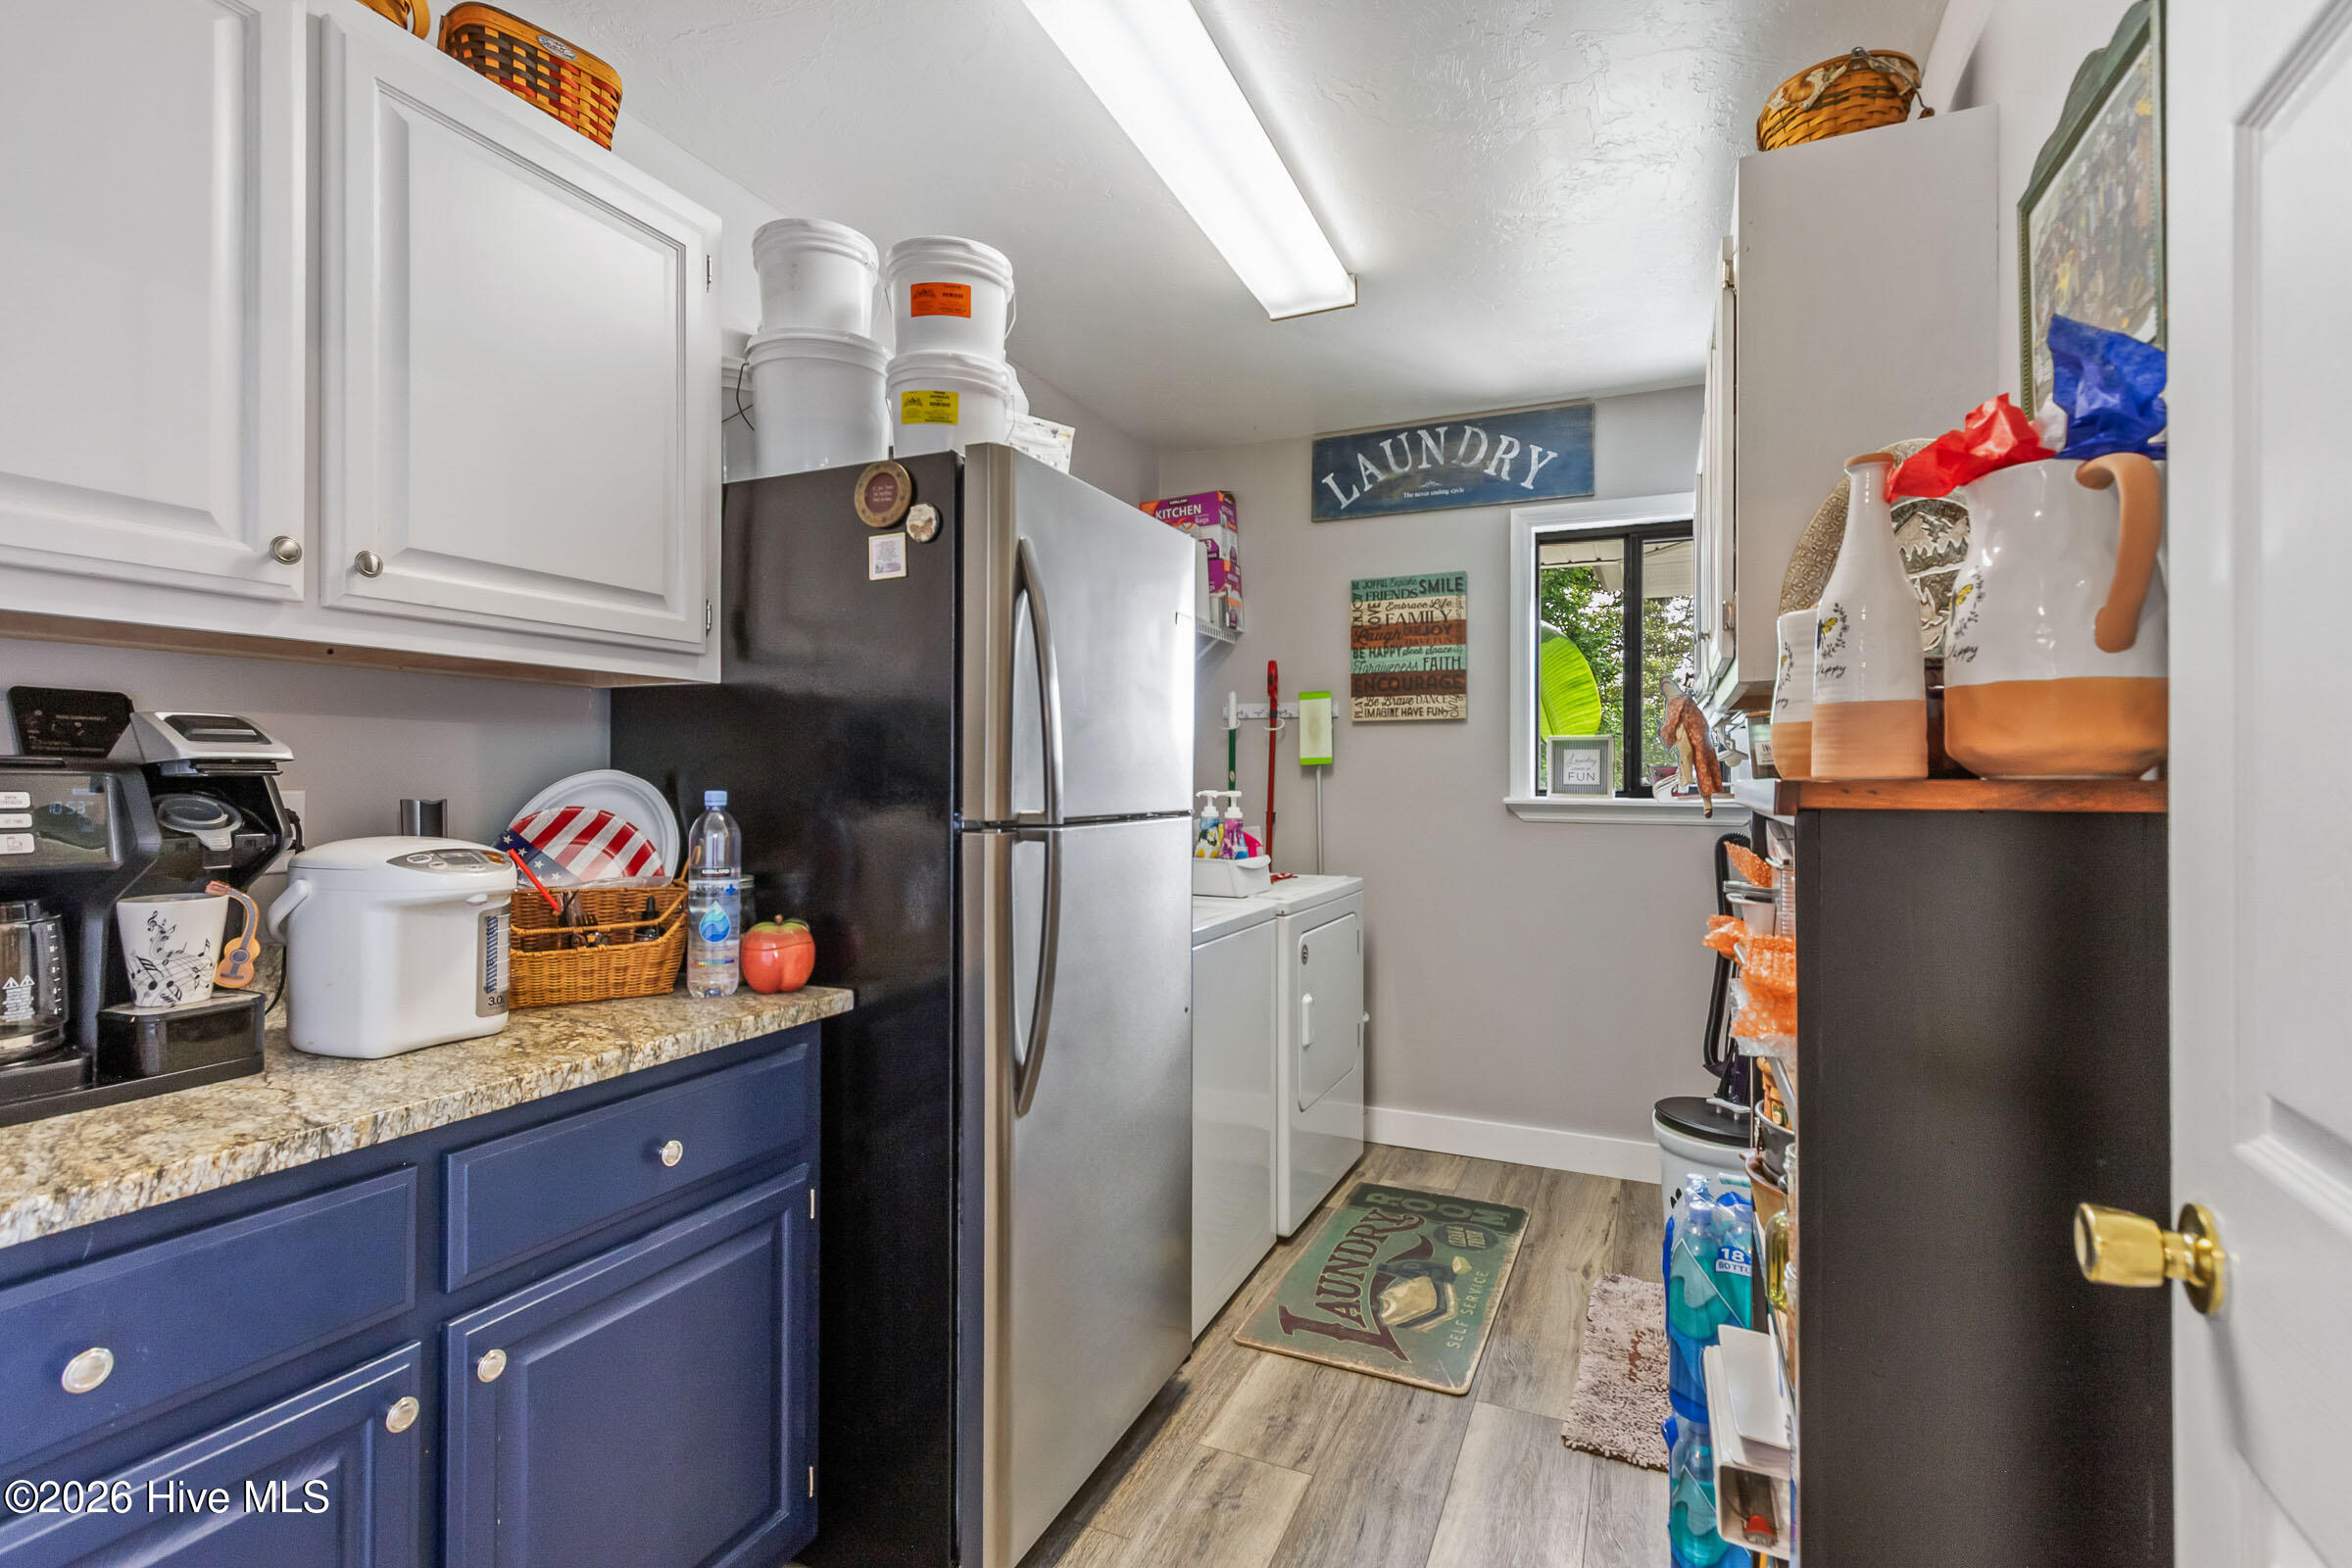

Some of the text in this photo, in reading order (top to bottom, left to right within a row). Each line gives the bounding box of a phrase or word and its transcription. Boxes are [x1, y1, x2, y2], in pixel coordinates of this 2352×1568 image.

[1322, 425, 1559, 509] LAUNDRY
[1155, 504, 1201, 519] KITCHEN
[1418, 576, 1464, 594] SMILE
[1365, 588, 1418, 602] FRIENDS
[1385, 598, 1452, 612] Embrace Life
[1386, 609, 1452, 626] FAMILY
[1352, 627, 1402, 647] Laugh
[1353, 647, 1365, 660] BE
[1369, 645, 1401, 659] HAPPY
[1423, 657, 1461, 670] FAITH
[1353, 673, 1464, 693] ENCOURAGE
[1364, 694, 1448, 707] Be Brave DANCE
[1364, 706, 1445, 717] IMAGINE HAVE FUN
[1568, 771, 1595, 782] FUN
[1365, 1192, 1512, 1228] ROOM
[1721, 1248, 1744, 1263] 18
[1718, 1261, 1751, 1274] BOTTL
[1277, 1207, 1425, 1364] LAUNDRY
[1446, 1269, 1491, 1349] SELF SERVICE
